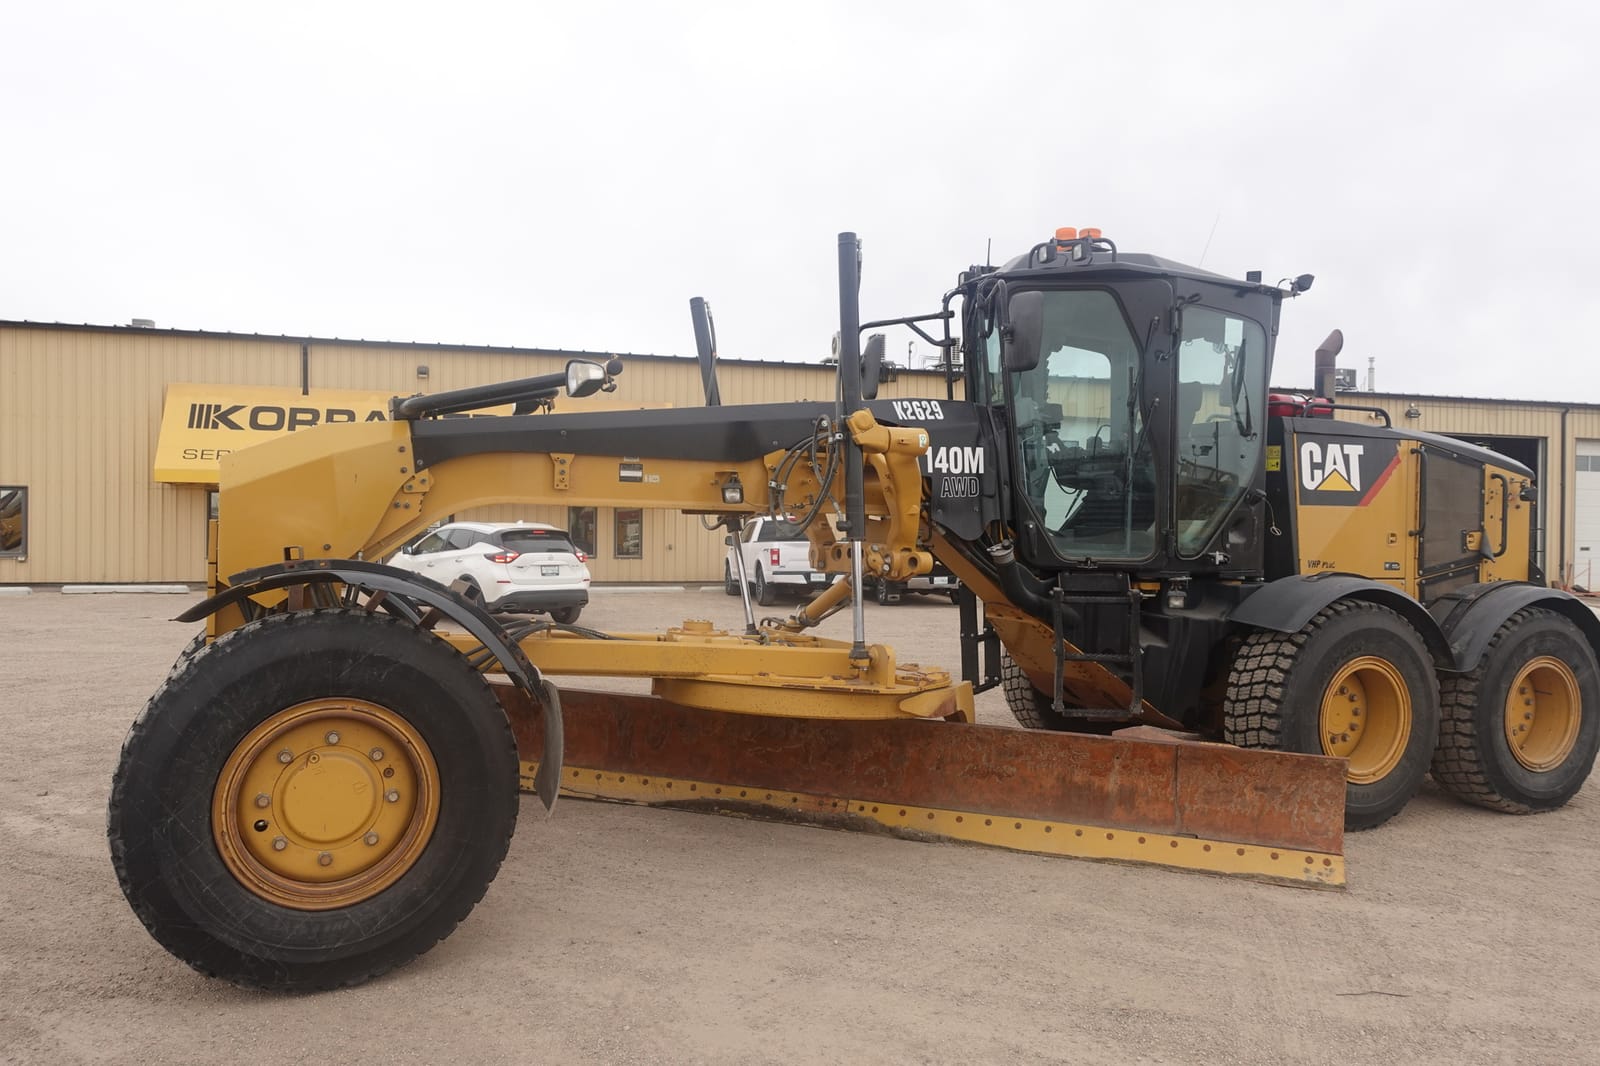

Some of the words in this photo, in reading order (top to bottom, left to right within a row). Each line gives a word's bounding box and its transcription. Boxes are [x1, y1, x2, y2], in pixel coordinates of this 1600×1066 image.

[892, 401, 944, 420] K2629
[925, 446, 985, 474] 140M
[1301, 442, 1364, 492] CAT
[940, 476, 980, 497] AWD
